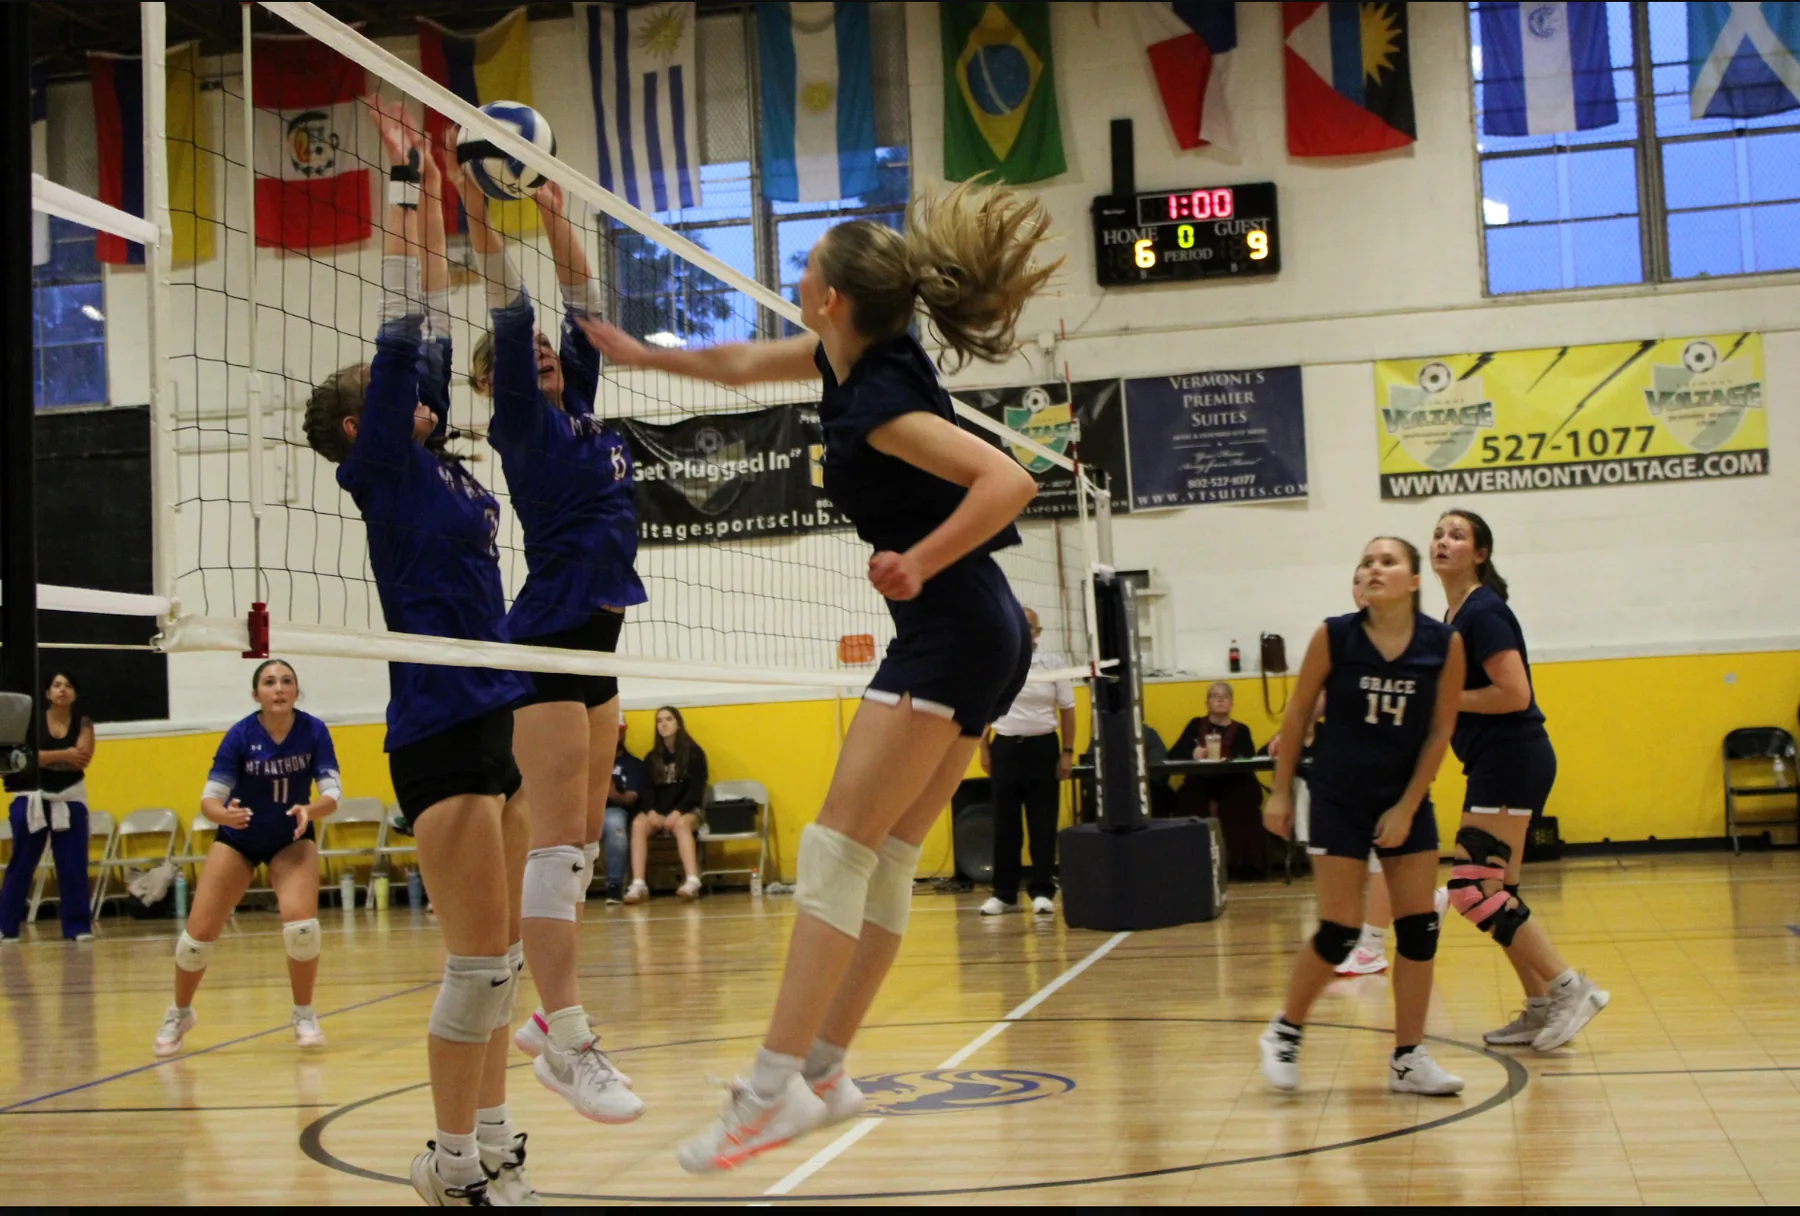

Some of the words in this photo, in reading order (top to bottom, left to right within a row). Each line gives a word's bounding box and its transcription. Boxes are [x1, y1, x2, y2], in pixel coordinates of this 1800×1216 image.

[1168, 189, 1232, 220] 1:00
[1103, 227, 1158, 245] HOME
[1177, 224, 1195, 249] 0
[1214, 218, 1271, 236] GUEST
[1134, 239, 1156, 268] 6
[1163, 248, 1213, 263] PERIOD
[1246, 230, 1268, 260] 9
[1183, 391, 1255, 409] PREMIER
[1191, 411, 1248, 427] SUITES
[1481, 425, 1656, 464] 527-1077
[670, 452, 765, 482] Plugged
[1389, 453, 1763, 497] WWW.VERMONTVOLTAGE.COM
[1359, 676, 1417, 694] GRACE
[1365, 693, 1407, 726] 14
[264, 753, 312, 776] ANTHONY
[273, 778, 289, 804] 11
